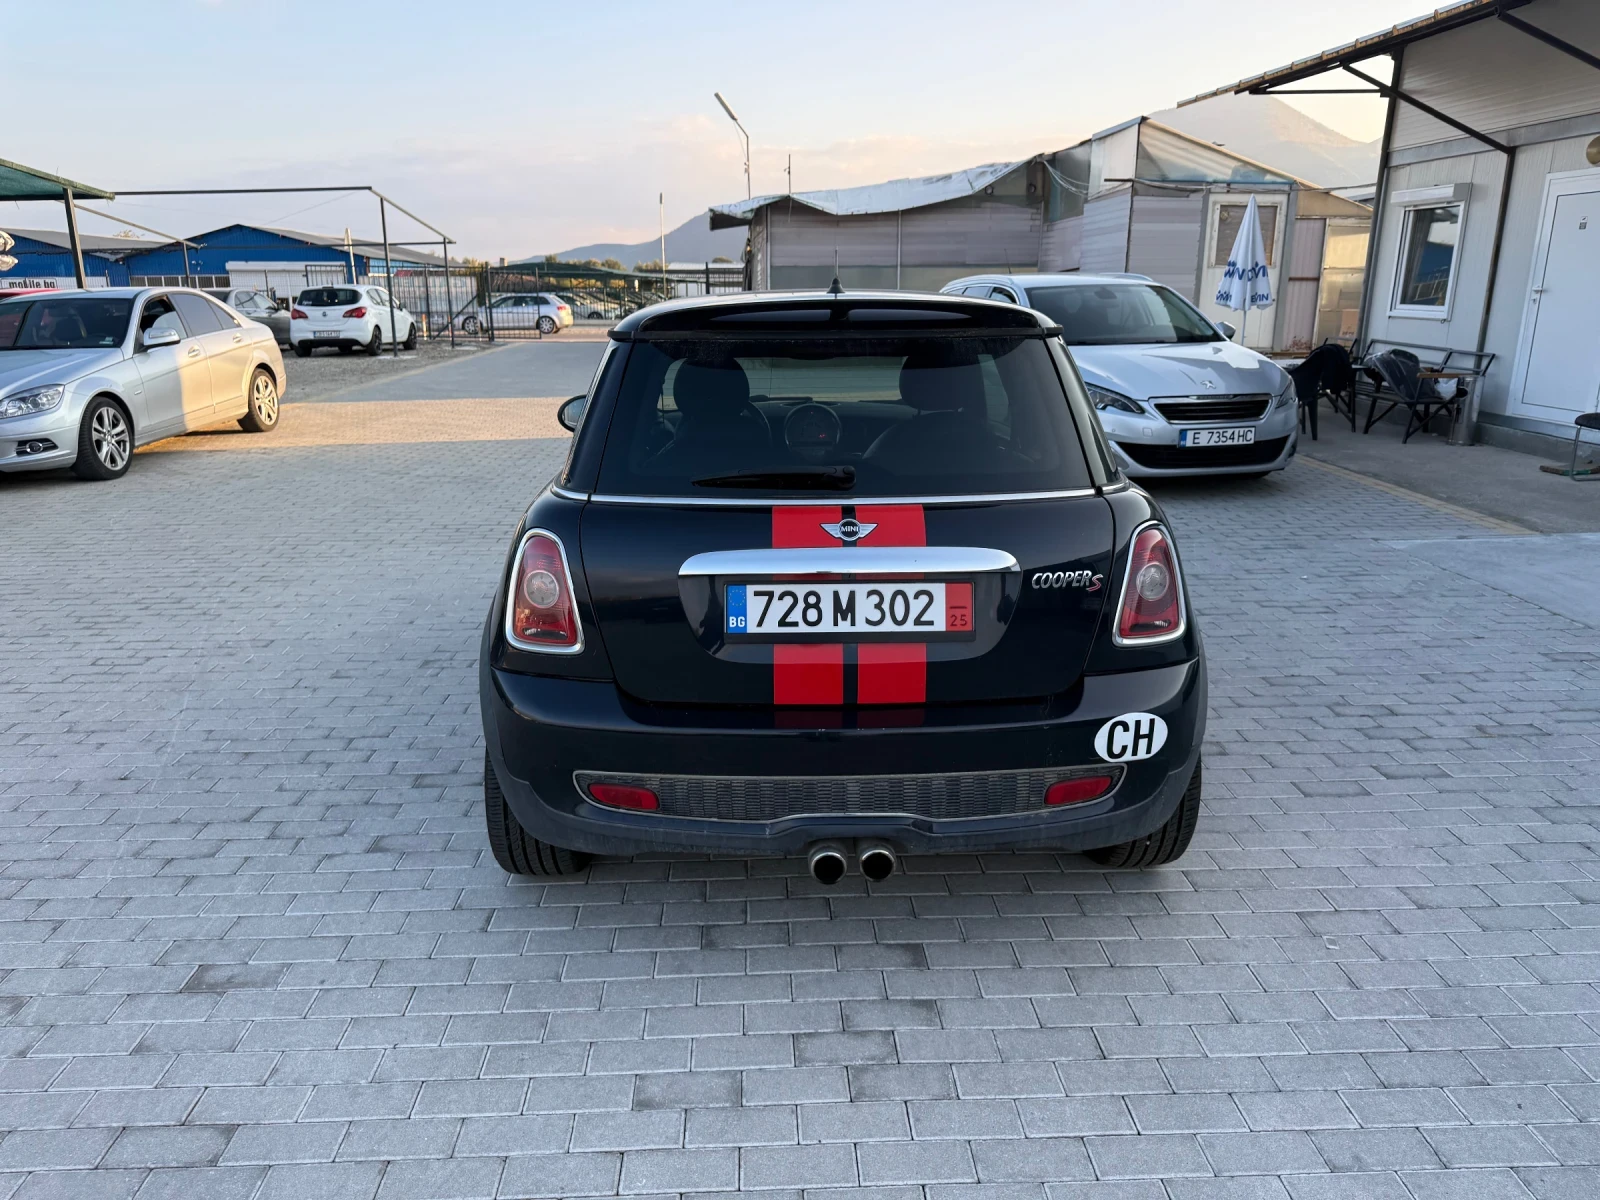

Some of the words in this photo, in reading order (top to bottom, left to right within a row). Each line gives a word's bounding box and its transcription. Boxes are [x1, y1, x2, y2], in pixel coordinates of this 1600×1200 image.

[1192, 432, 1201, 445] E
[1207, 430, 1236, 445] 7354
[1237, 429, 1253, 443] HC
[753, 590, 823, 628] 728
[832, 590, 856, 627] M
[865, 589, 935, 627] 302
[729, 616, 746, 628] BG
[950, 614, 968, 627] 25
[1106, 717, 1156, 760] CH
